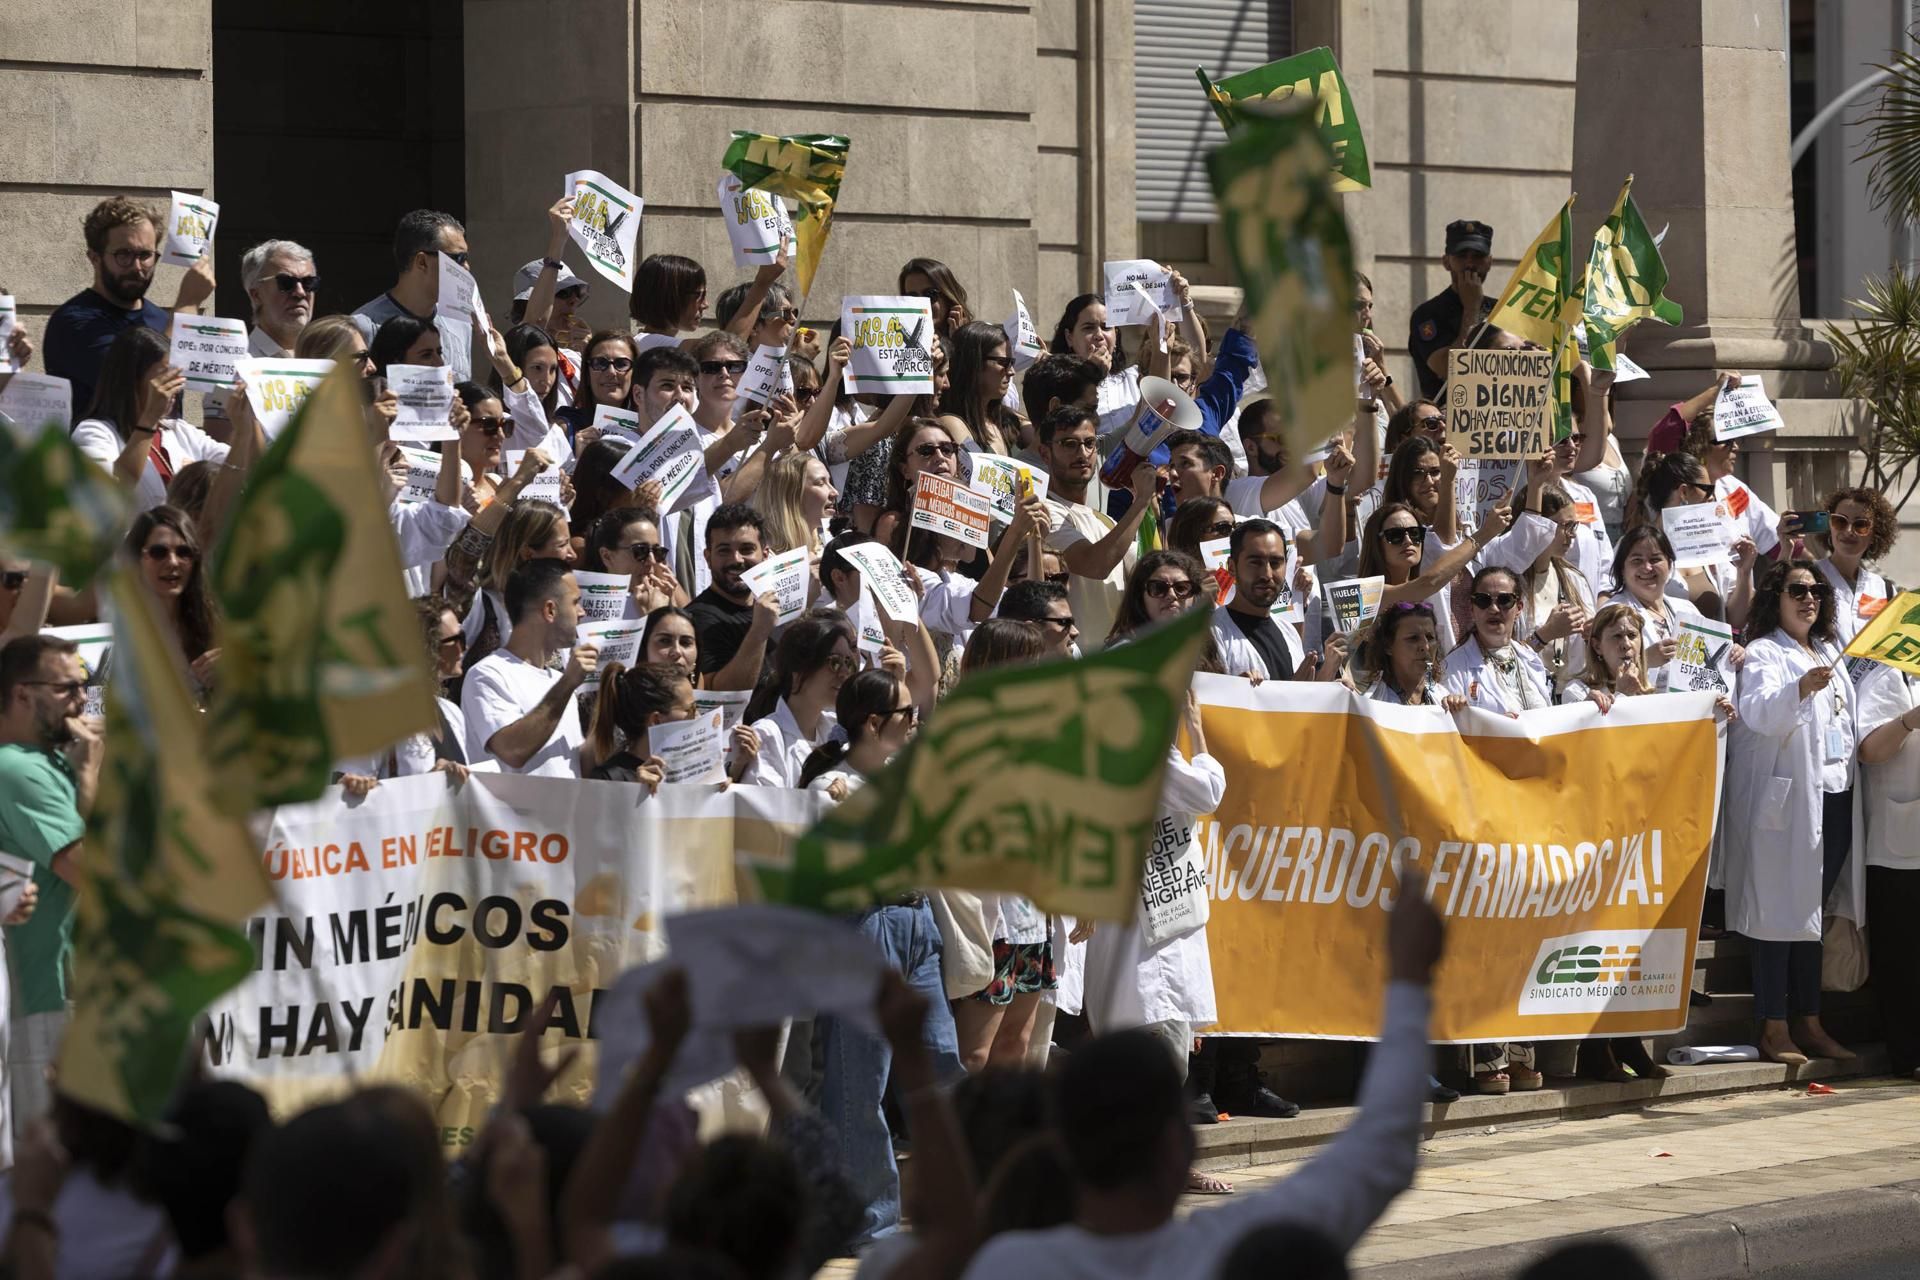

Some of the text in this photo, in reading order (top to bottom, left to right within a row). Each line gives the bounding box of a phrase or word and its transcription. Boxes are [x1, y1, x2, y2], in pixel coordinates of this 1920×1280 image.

[582, 225, 617, 252] ESTATUTO
[855, 315, 902, 338] ¡NO AL
[854, 331, 904, 350] NUEVO
[879, 348, 924, 360] ESTATUTO
[189, 361, 235, 376] DE MÉRITOS
[754, 364, 774, 377] OPEs
[1476, 377, 1547, 408] DIGNAS
[1735, 400, 1745, 408] NO
[649, 455, 666, 473] POR
[663, 427, 693, 459] CONCURSO
[1469, 431, 1543, 455] SEGURA
[667, 450, 693, 482] MÉRITOS
[410, 485, 421, 497] DE
[918, 475, 954, 501] ¡HUELGA!
[928, 495, 956, 518] MÉDICOS
[582, 600, 594, 609] UN
[1333, 588, 1360, 599] HUELGA
[1680, 663, 1719, 682] ESTATUTO
[263, 841, 371, 881] ÚBLICA
[381, 835, 417, 869] EN
[1145, 851, 1175, 876] UST
[1141, 860, 1197, 896] NEED A
[1425, 839, 1613, 919] FIRMADOS
[1606, 829, 1663, 906] YA!
[1142, 869, 1206, 912] HIGH-FIVE
[1150, 918, 1168, 930] WITH
[1157, 909, 1169, 921] THE
[251, 891, 570, 971] IN MÉDICOS
[1536, 945, 1642, 985] CESM
[1530, 983, 1675, 1000] SINDICATO MÉDICO CANARIO
[257, 997, 375, 1059] HAY
